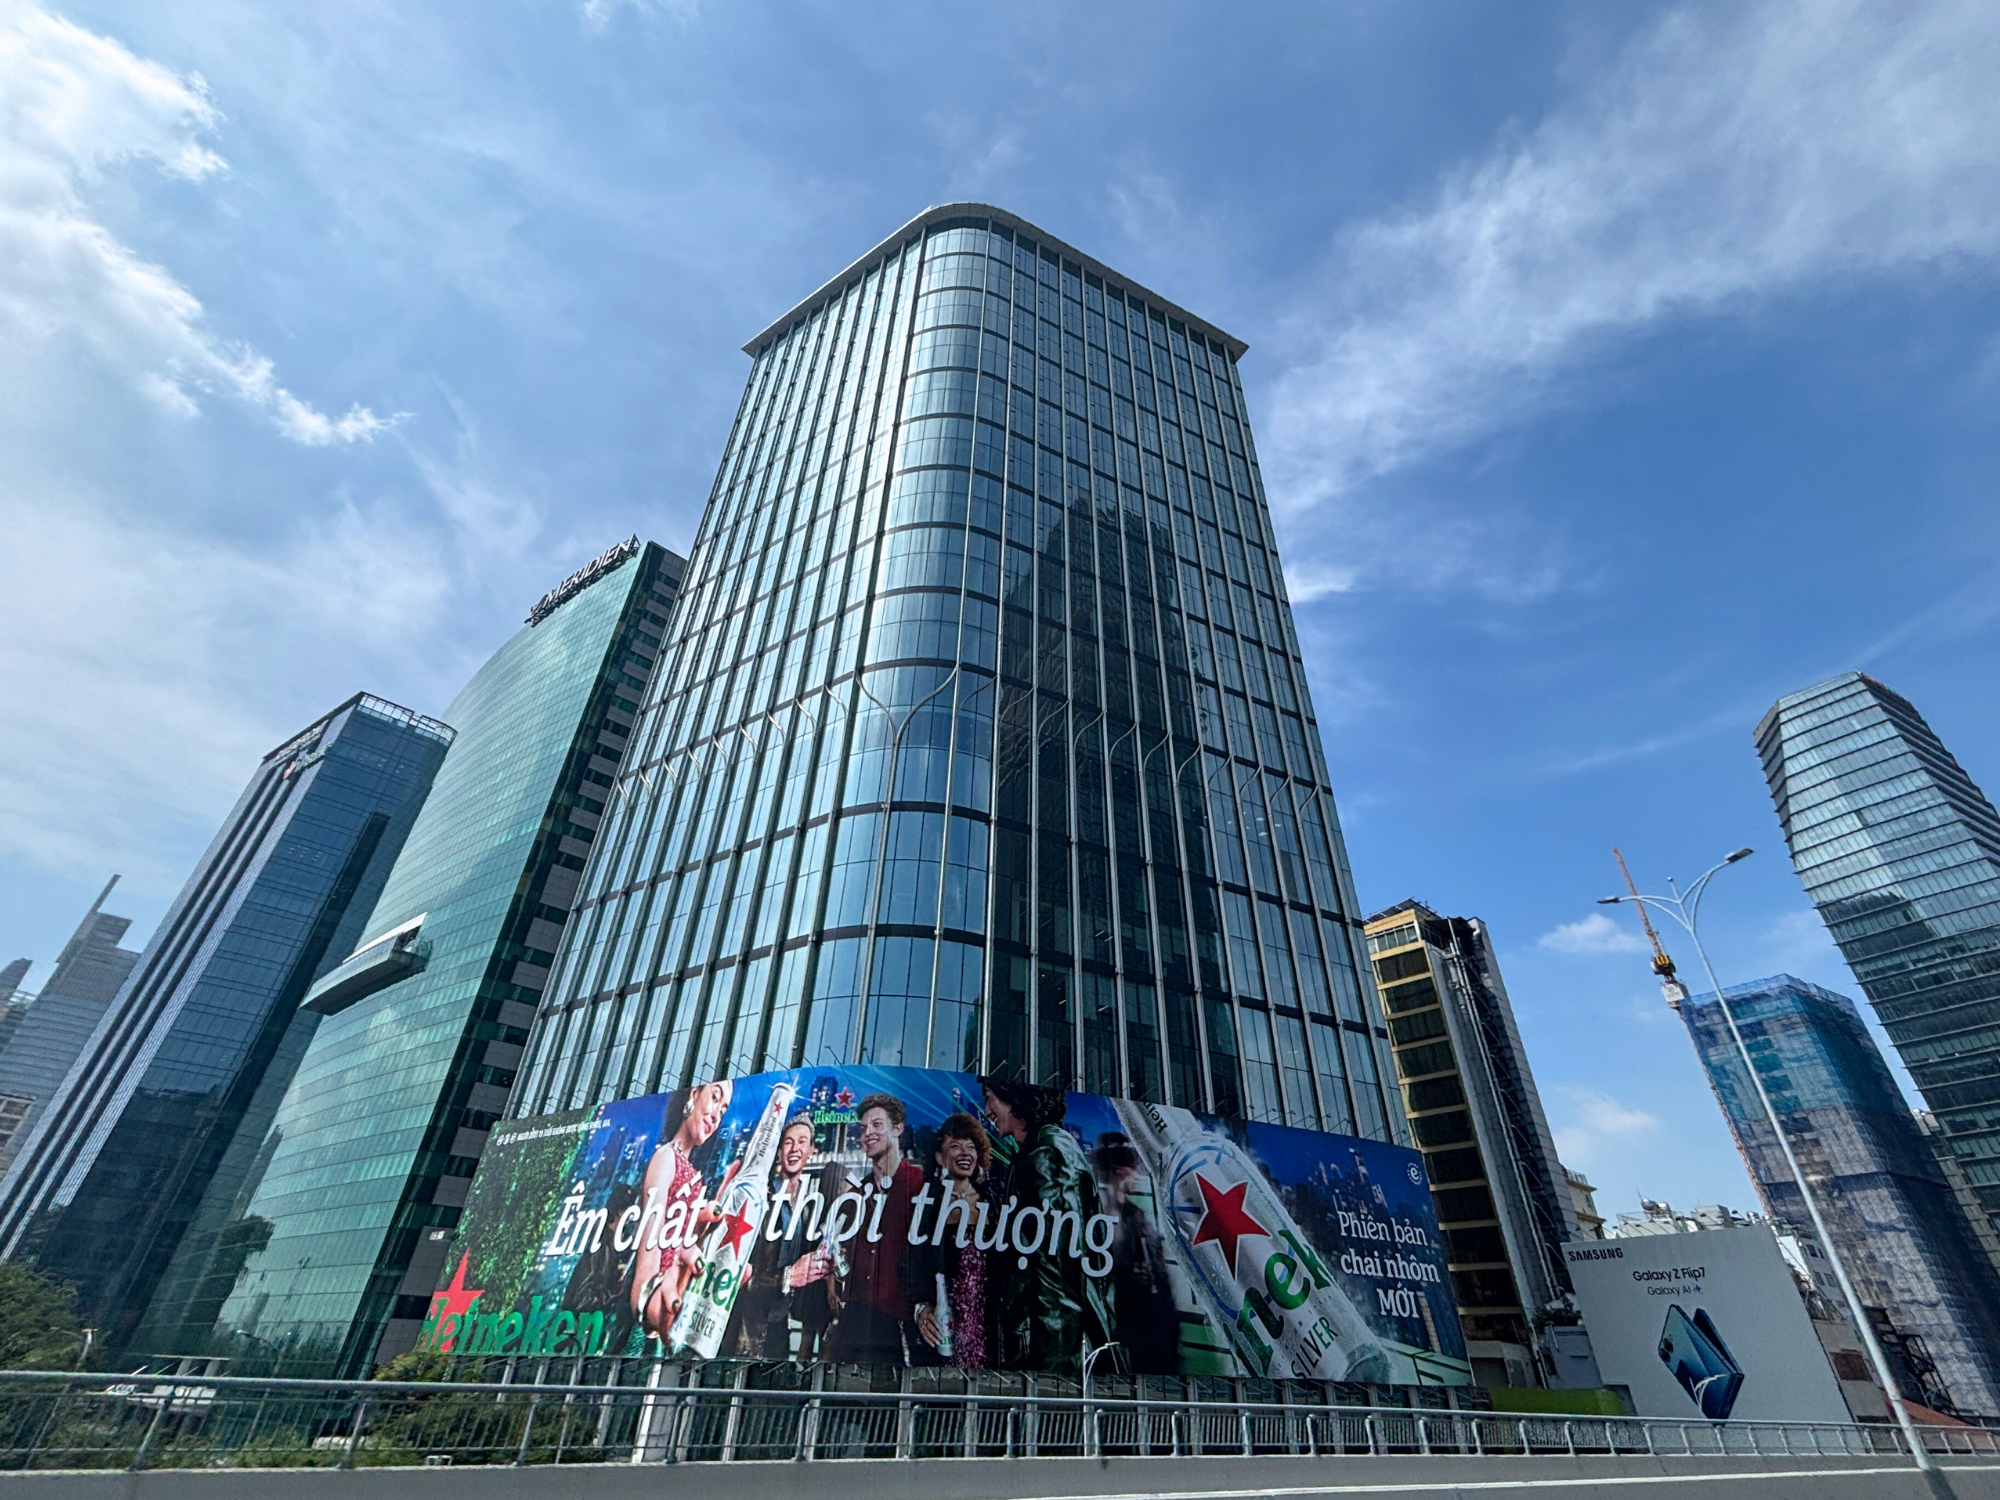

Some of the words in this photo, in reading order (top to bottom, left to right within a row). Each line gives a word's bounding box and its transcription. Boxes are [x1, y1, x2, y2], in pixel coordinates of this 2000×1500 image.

[546, 1180, 608, 1255] Êm
[613, 1170, 708, 1252] chất
[764, 1173, 893, 1244] thời
[906, 1175, 1120, 1278] thượng
[1338, 1210, 1391, 1242] Phiên
[1390, 1217, 1429, 1246] bản
[1340, 1248, 1384, 1277] chai
[1384, 1252, 1441, 1283] nhôm
[1567, 1246, 1624, 1262] SAMSUNG
[1632, 1269, 1672, 1283] Galaxy
[1673, 1268, 1681, 1280] Z
[1681, 1266, 1706, 1282] Flip7
[1647, 1285, 1680, 1297] Galaxy
[1682, 1285, 1692, 1296] AI
[1376, 1281, 1420, 1318] MỚI
[413, 1295, 605, 1356] Heineken
[689, 1310, 716, 1338] SILVER
[1290, 1316, 1338, 1378] SILVER
